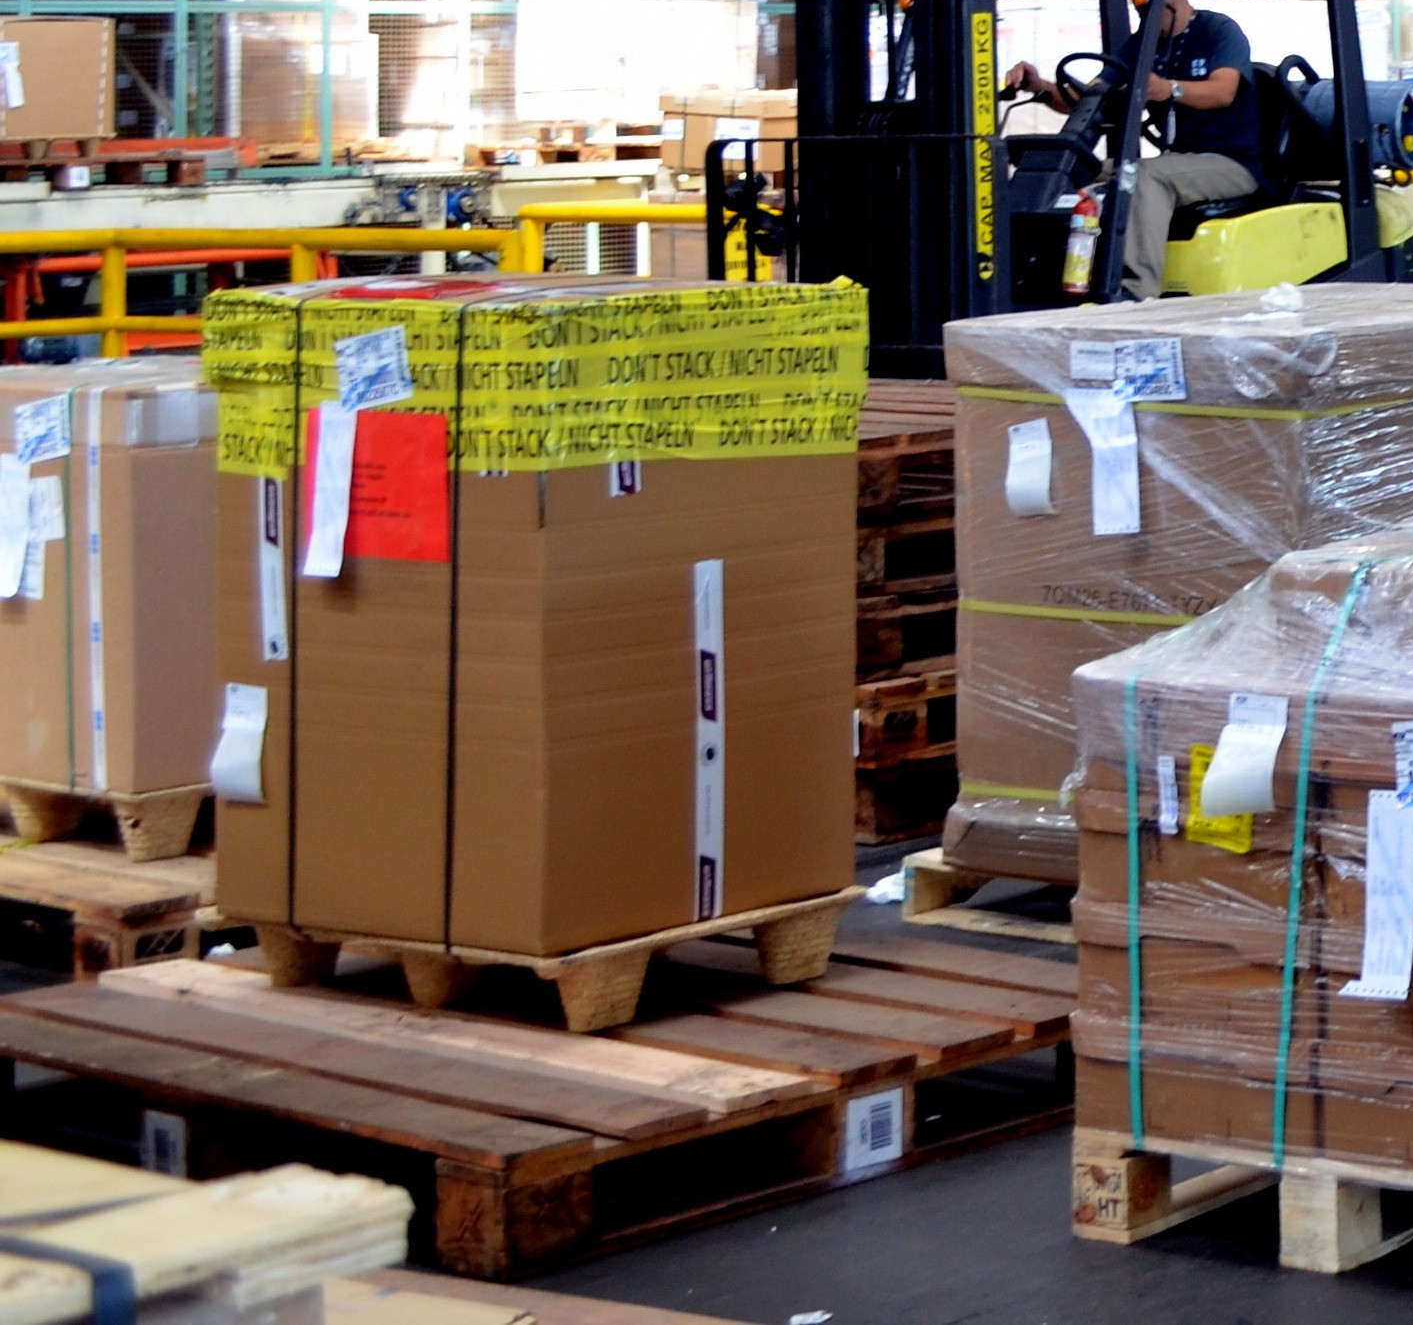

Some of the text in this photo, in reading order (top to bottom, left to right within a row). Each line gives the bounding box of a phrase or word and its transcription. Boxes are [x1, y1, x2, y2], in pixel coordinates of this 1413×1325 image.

[976, 17, 990, 55] KG
[977, 62, 991, 116] 2200
[506, 361, 579, 390] STAPELN
[608, 354, 660, 384] DON'T
[664, 351, 715, 380] STACK
[728, 348, 773, 376] NICHT
[777, 346, 839, 374] STAPELN
[497, 429, 551, 458] STACK
[569, 423, 622, 454] NICHT
[626, 421, 695, 449] STAPELN
[719, 419, 766, 447] DON'T
[771, 418, 815, 445] STACK
[1098, 1197, 1120, 1218] HT
